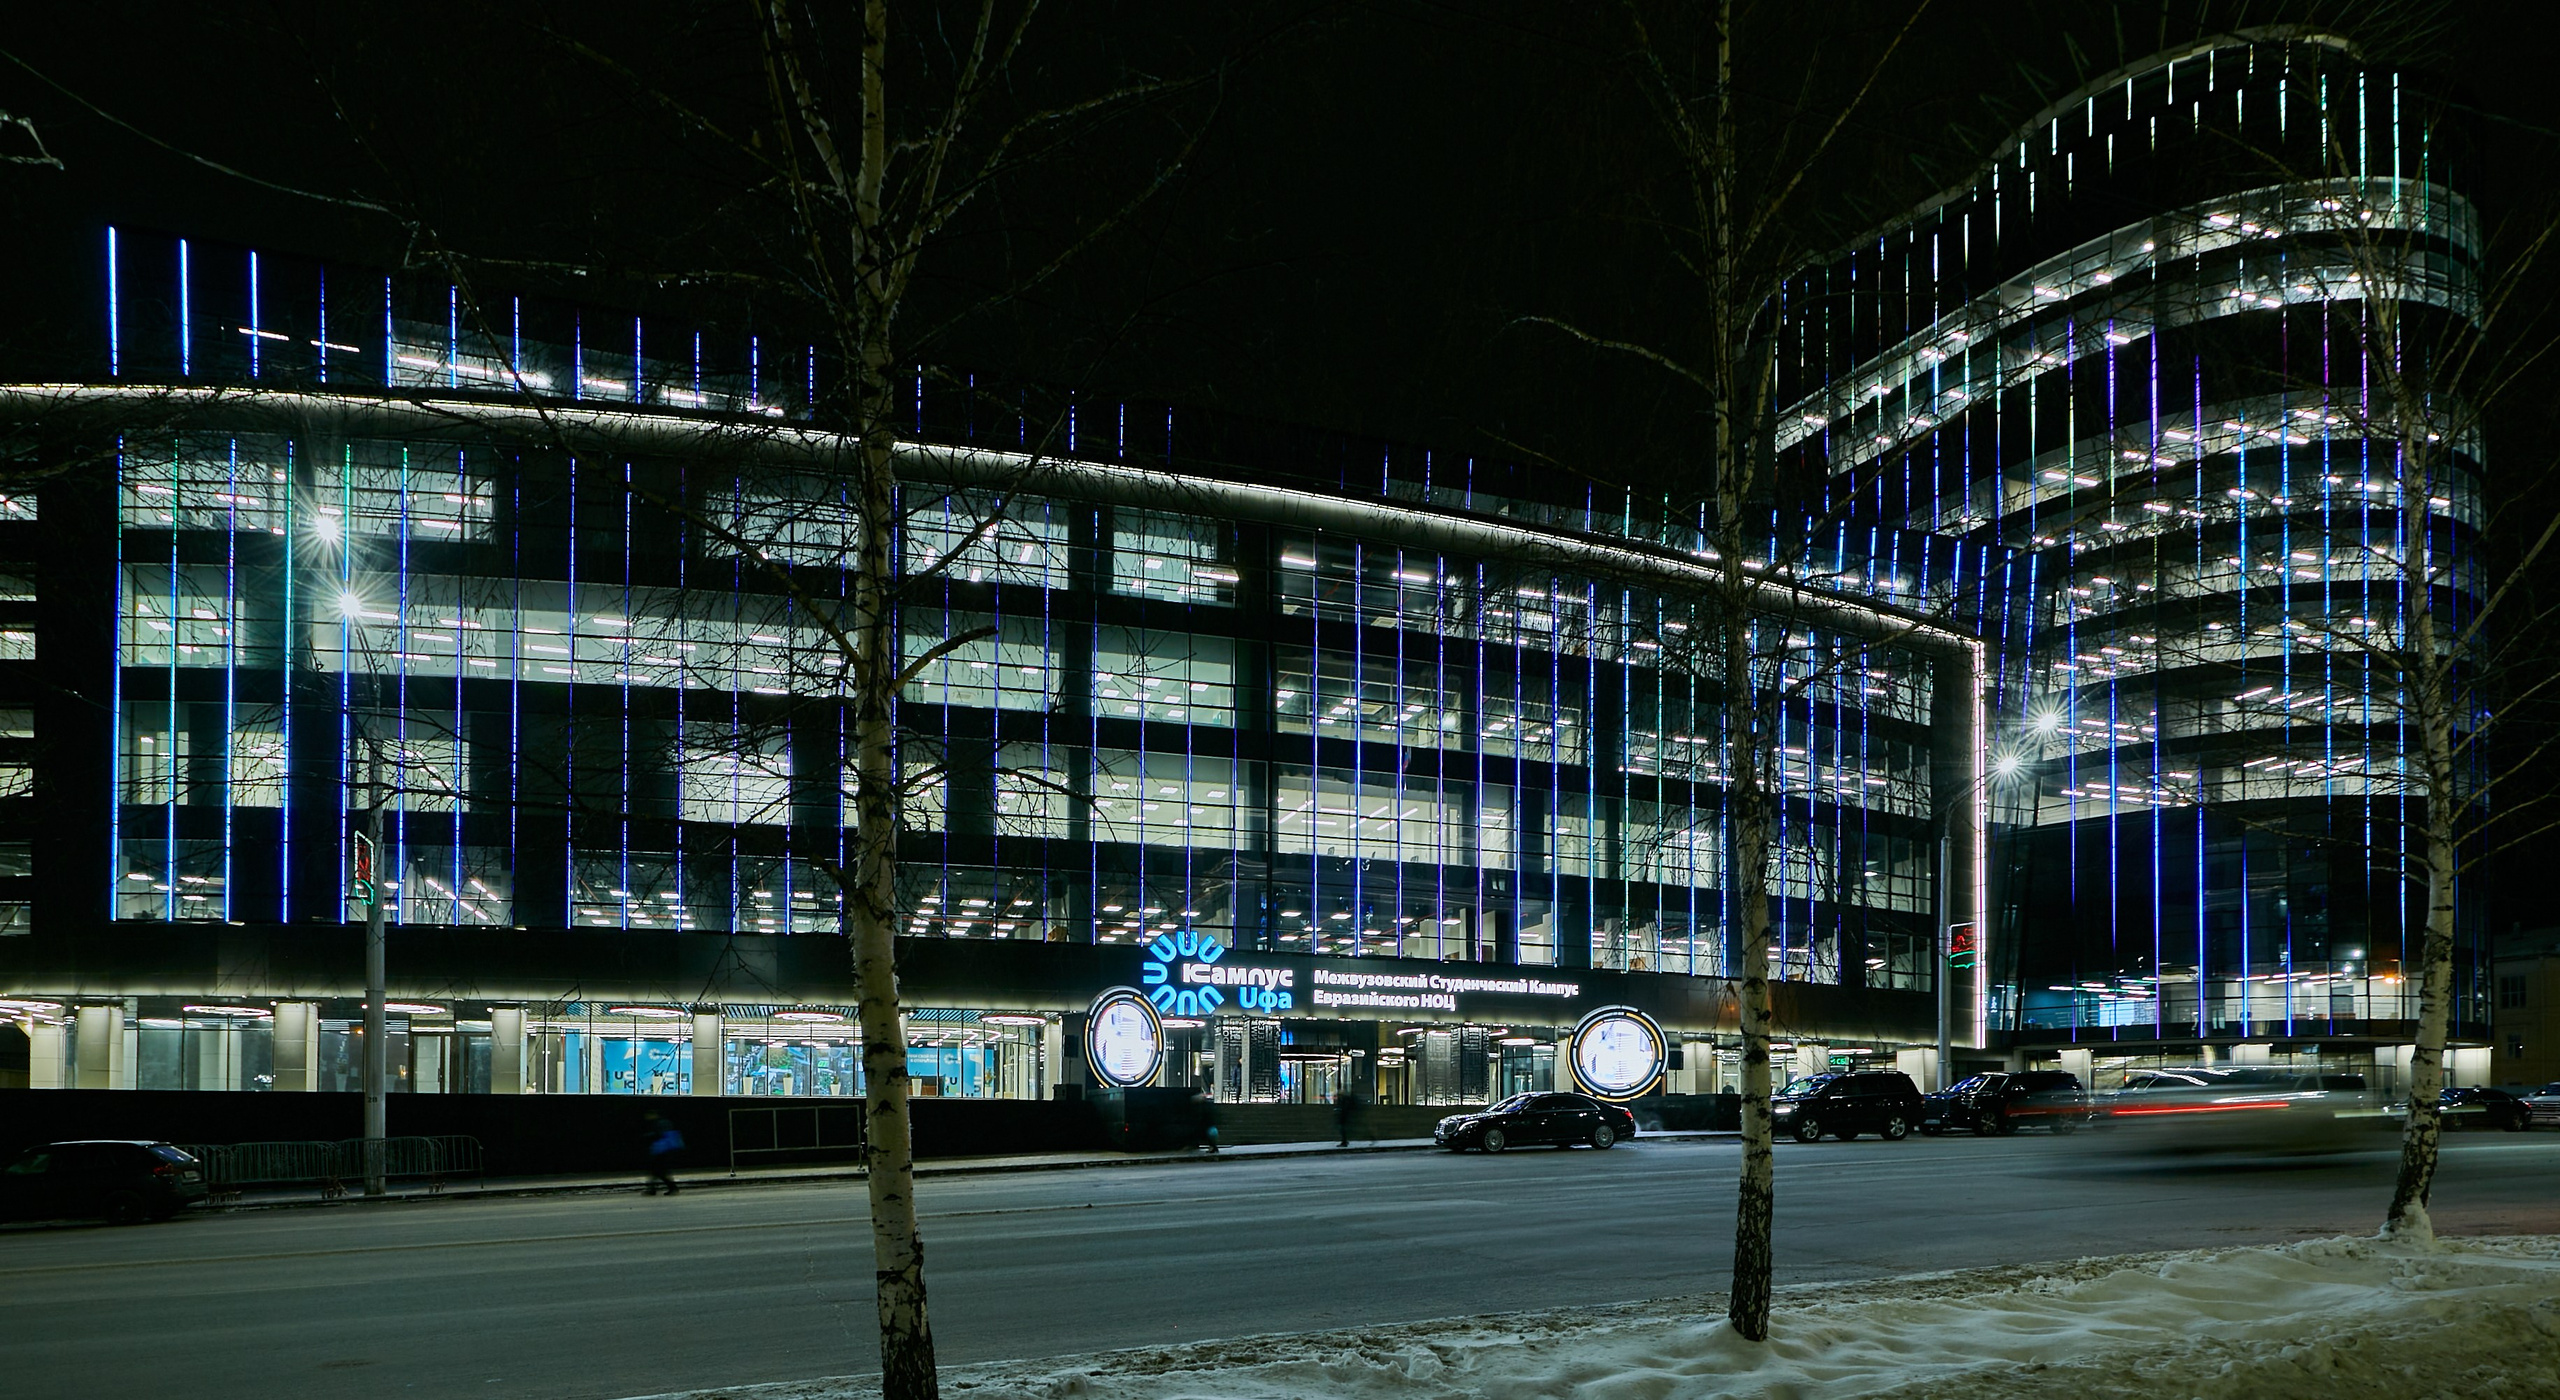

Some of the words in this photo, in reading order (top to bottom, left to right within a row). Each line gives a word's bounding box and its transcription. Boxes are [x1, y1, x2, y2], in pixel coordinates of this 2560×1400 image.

[1182, 963, 1294, 991] Кампус
[1313, 969, 1428, 989] Межвузовский
[1429, 974, 1528, 993] Студенческий
[1529, 979, 1579, 998] Кампус
[1313, 989, 1420, 1008] Евразийского
[1420, 993, 1456, 1011] НОЦ
